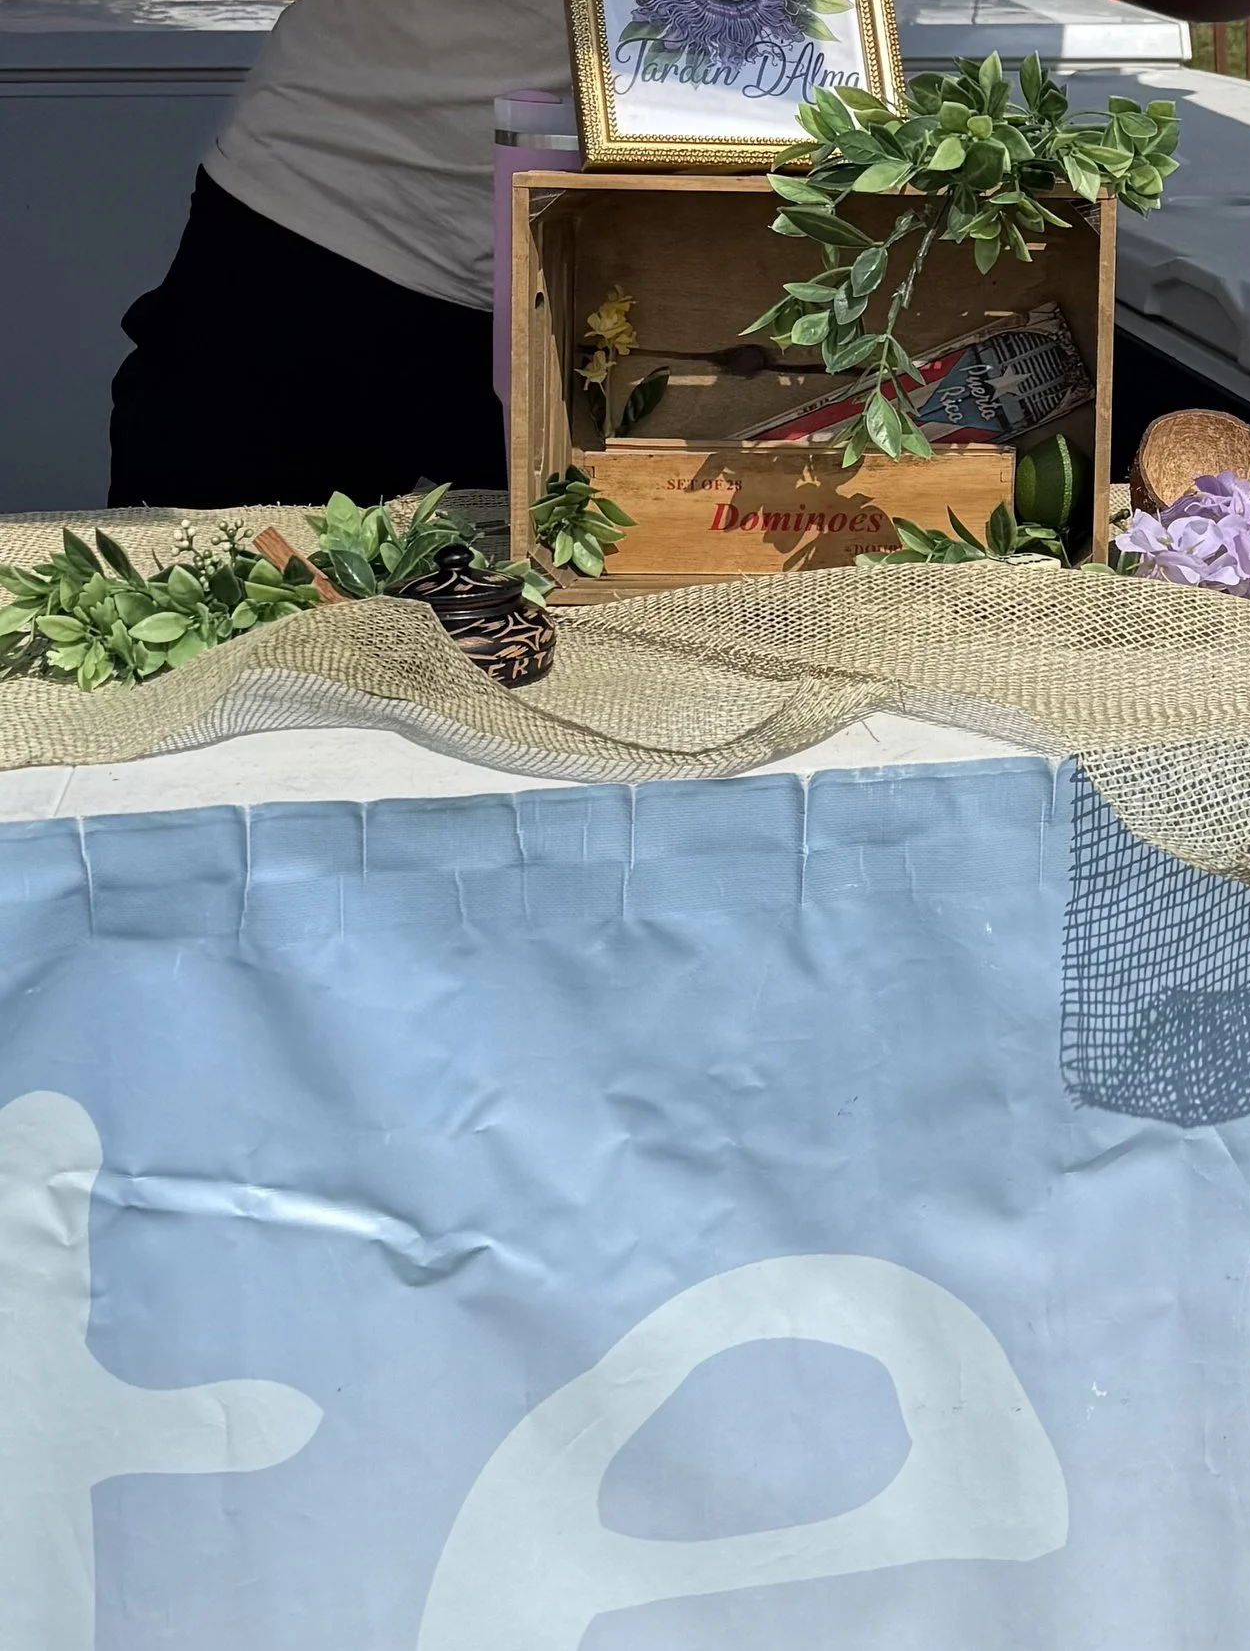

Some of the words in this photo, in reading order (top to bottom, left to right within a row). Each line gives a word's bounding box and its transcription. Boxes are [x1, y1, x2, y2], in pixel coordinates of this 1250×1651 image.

[936, 386, 964, 424] Rico
[960, 364, 1003, 421] Puerto
[666, 478, 698, 491] SET
[701, 478, 723, 491] OF
[707, 502, 884, 534] Dominoes
